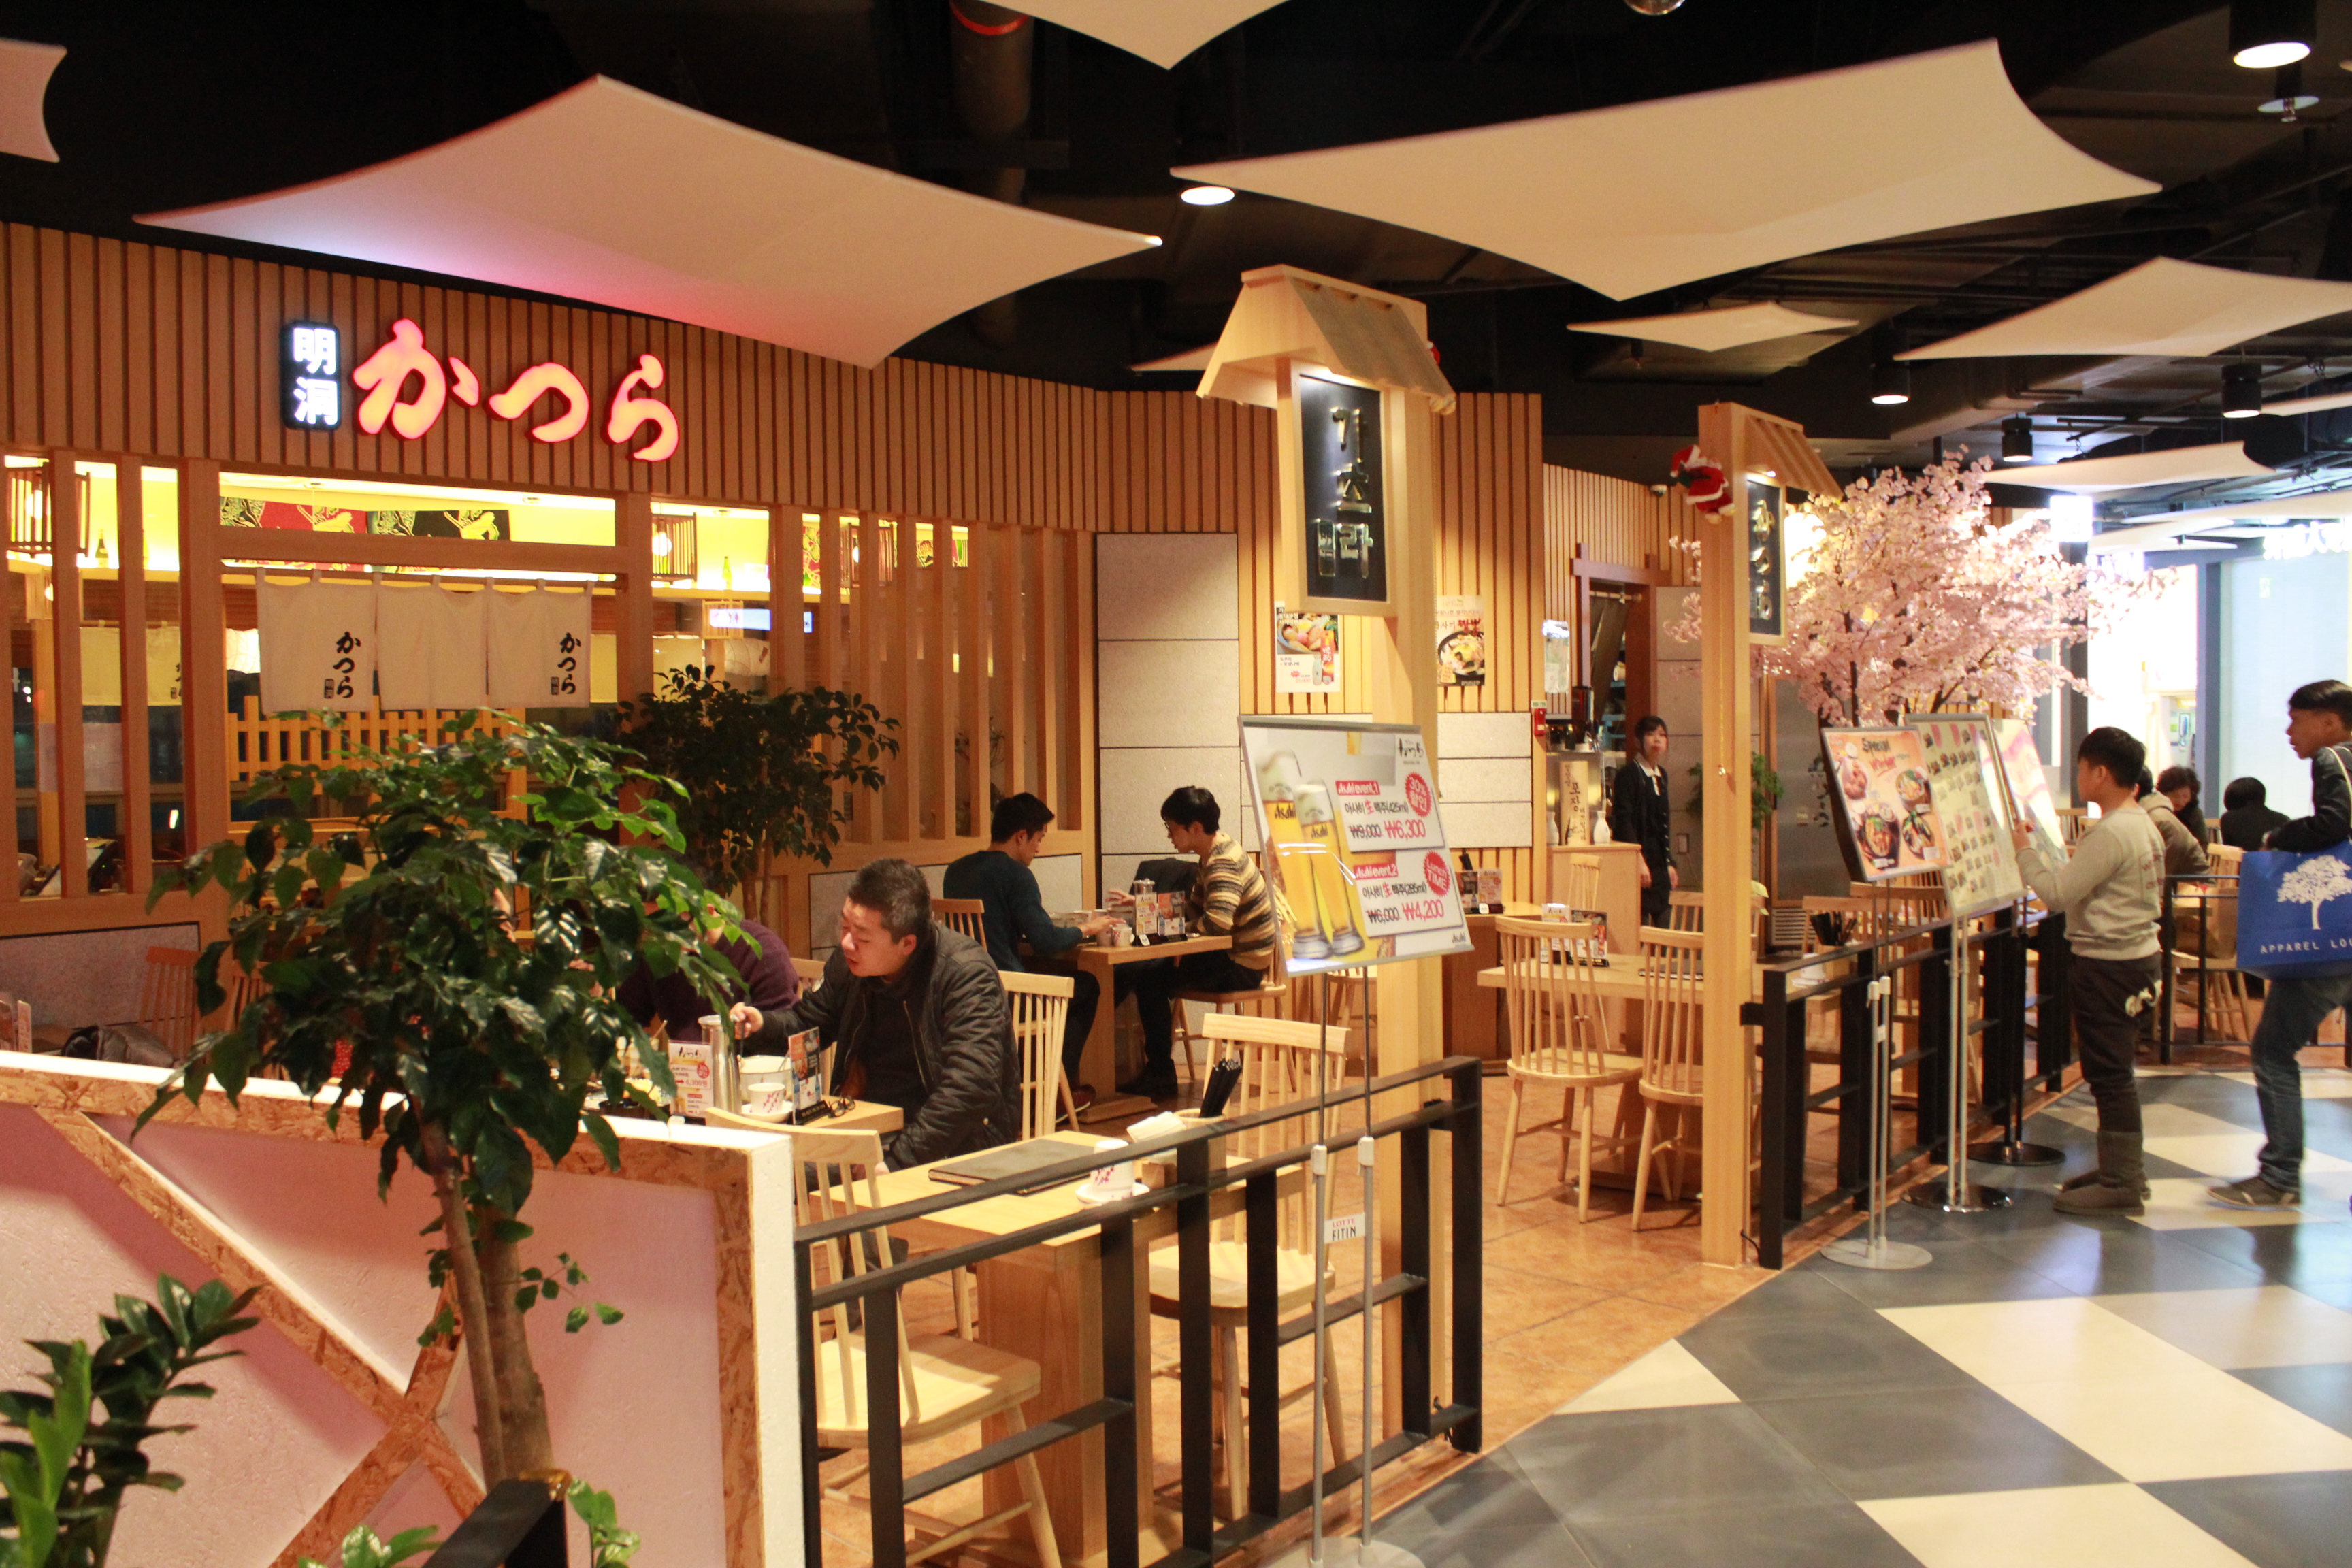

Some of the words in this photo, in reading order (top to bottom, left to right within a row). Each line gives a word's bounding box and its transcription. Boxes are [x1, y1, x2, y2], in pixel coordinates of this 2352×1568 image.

[293, 327, 338, 425] 明洞
[353, 318, 679, 461] かつら
[332, 632, 361, 698] かつら
[557, 632, 581, 694] かつら
[2260, 941, 2320, 954] APPAREL
[1332, 1218, 1355, 1228] LOTTE
[1332, 1226, 1356, 1241] FITIN
